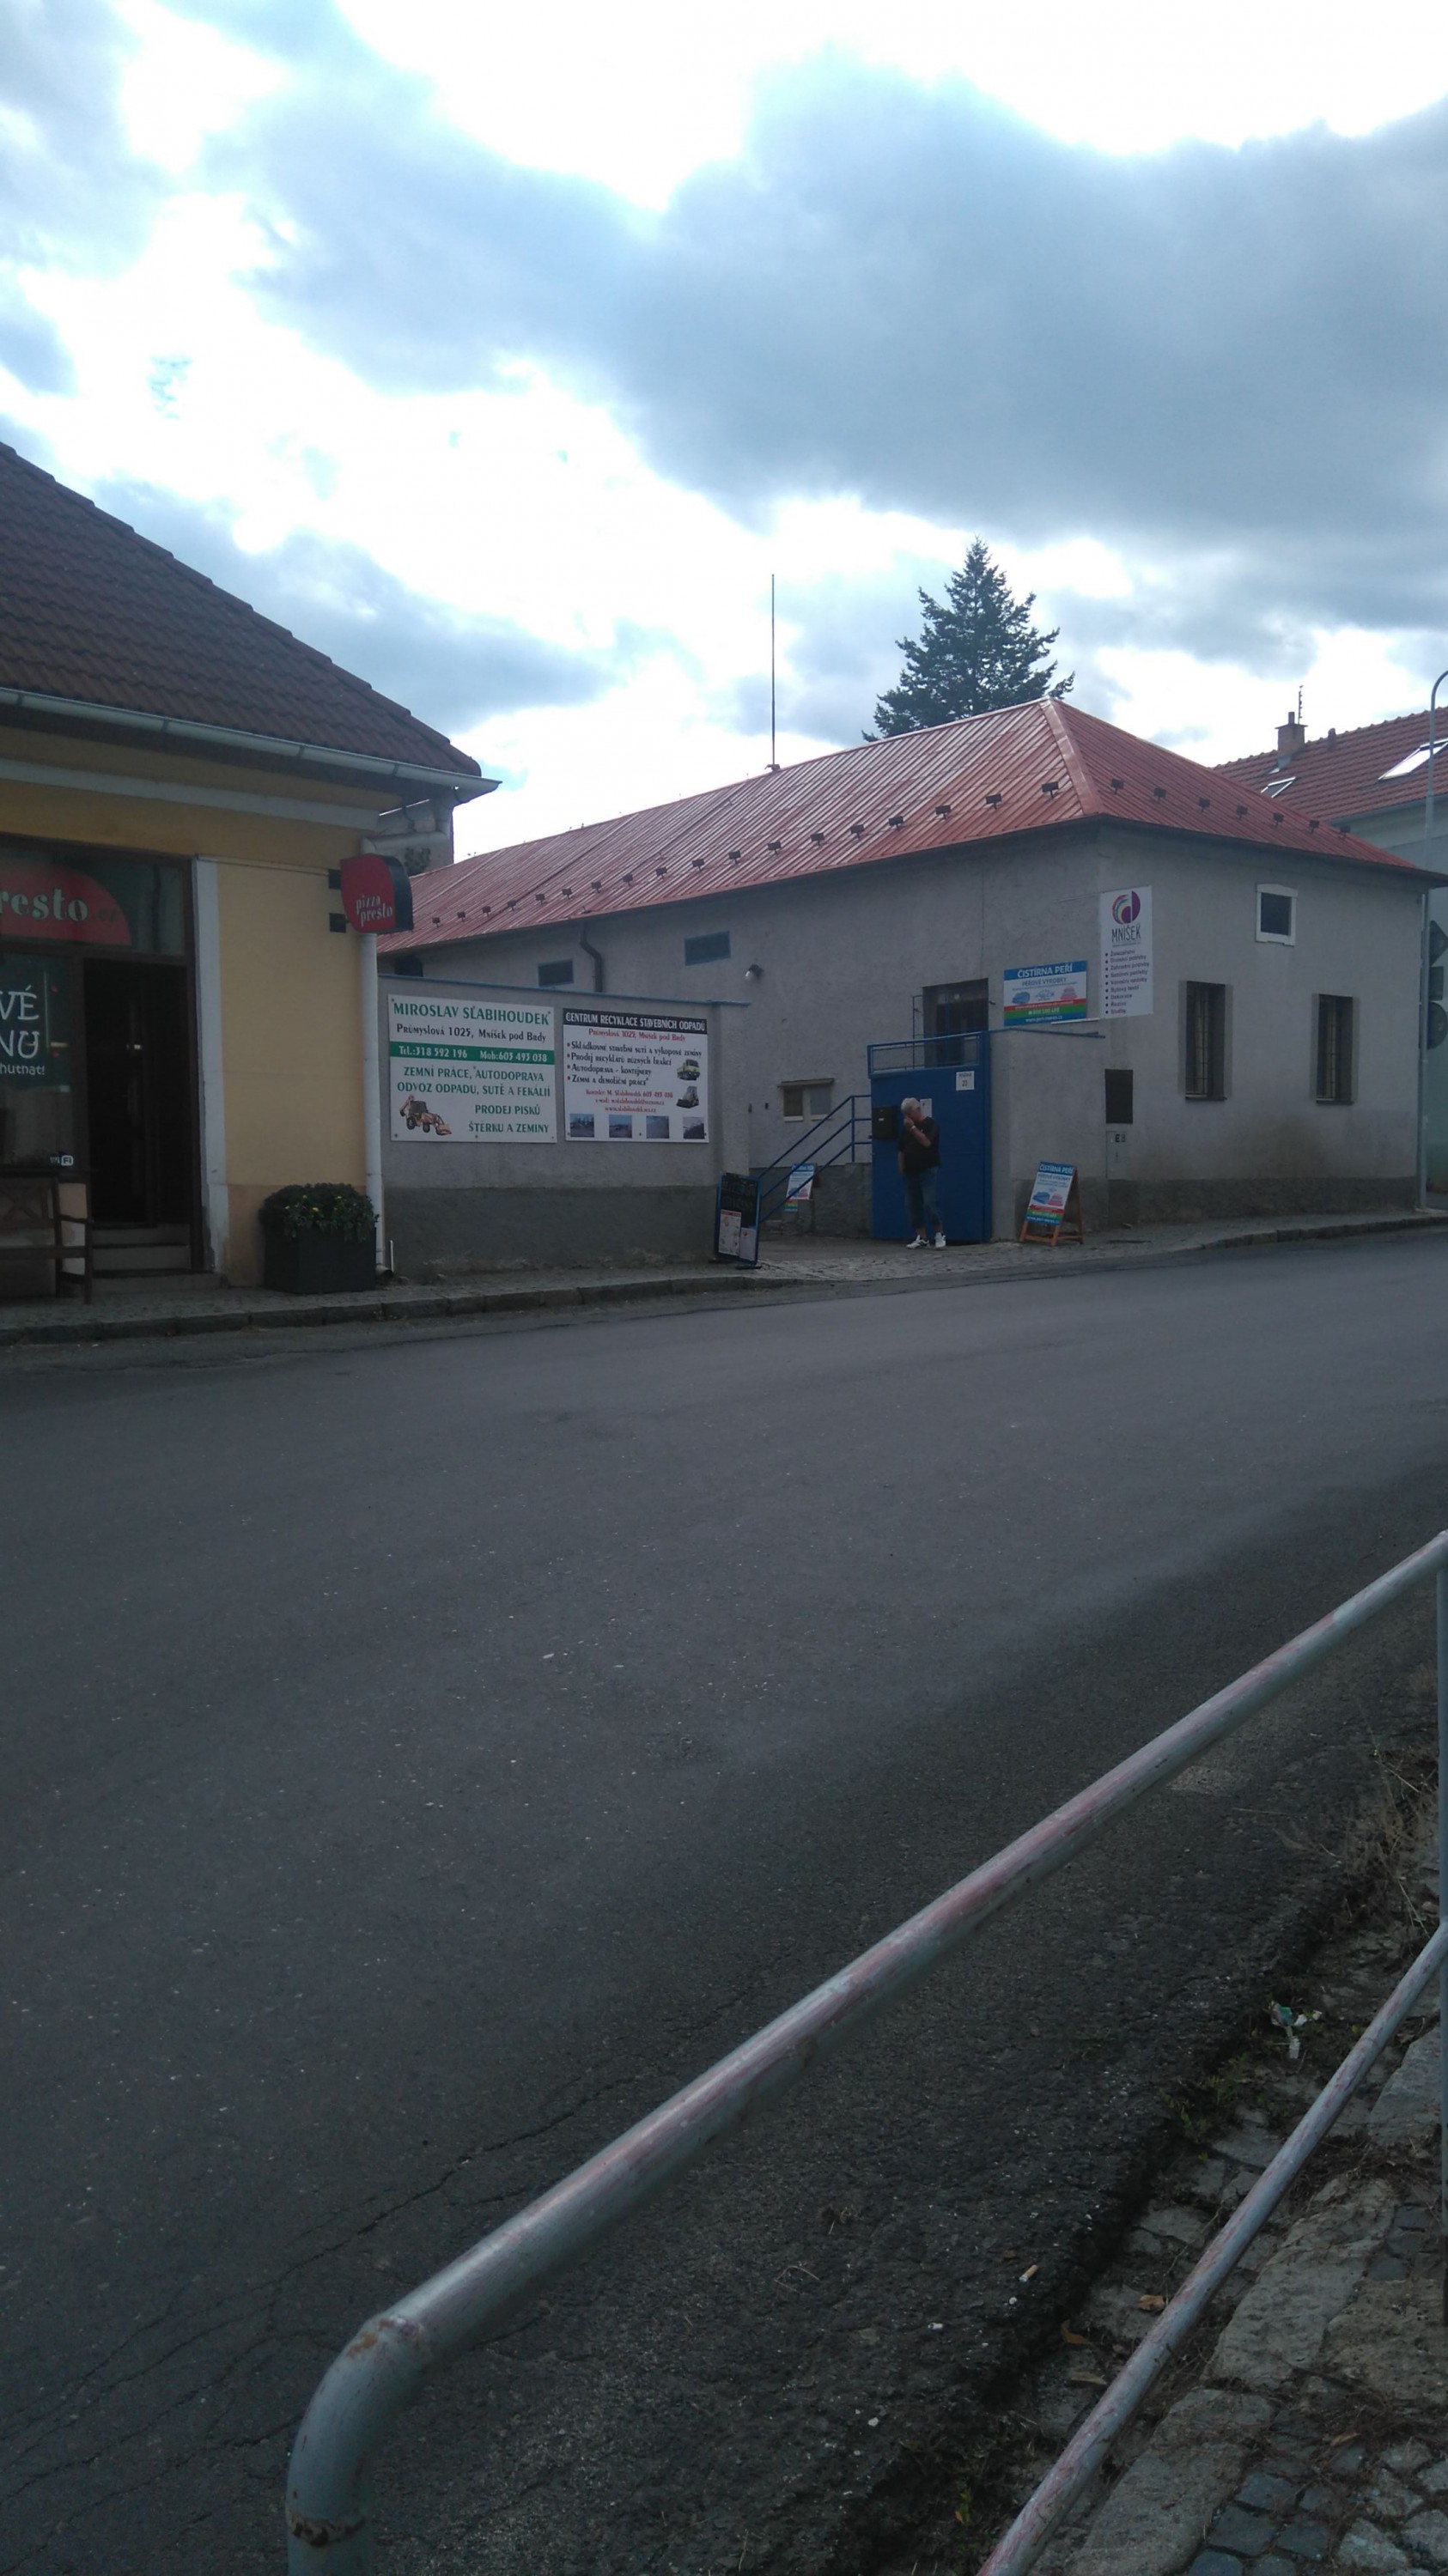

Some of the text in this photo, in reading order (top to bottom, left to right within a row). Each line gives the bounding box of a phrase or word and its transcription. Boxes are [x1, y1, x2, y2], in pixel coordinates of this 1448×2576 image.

[356, 895, 380, 914] pizza
[361, 903, 392, 927] presto
[1017, 963, 1073, 978] ČISTÍRNA PEŘÍ
[393, 1003, 549, 1025] MIROSLAV SLABIHOUDEK
[566, 1012, 705, 1031] CENTRUM RECYKLACE STAVEBNÍCH ODPADŮ
[448, 1028, 473, 1038] 1025,
[508, 1031, 524, 1042] pod
[434, 1048, 449, 1058] 592
[452, 1049, 467, 1059] 196
[515, 1052, 530, 1061] 493
[532, 1053, 547, 1062] 038
[404, 1066, 545, 1082] ZEMNÍ PRÁCE, AUTODOPRAVA
[397, 1082, 432, 1093] ODVOZ
[435, 1084, 479, 1095] ODPADU,
[508, 1087, 514, 1096] A
[475, 1104, 511, 1115] PRODEJ
[507, 1123, 514, 1133] A
[516, 1123, 549, 1133] ZEMINY
